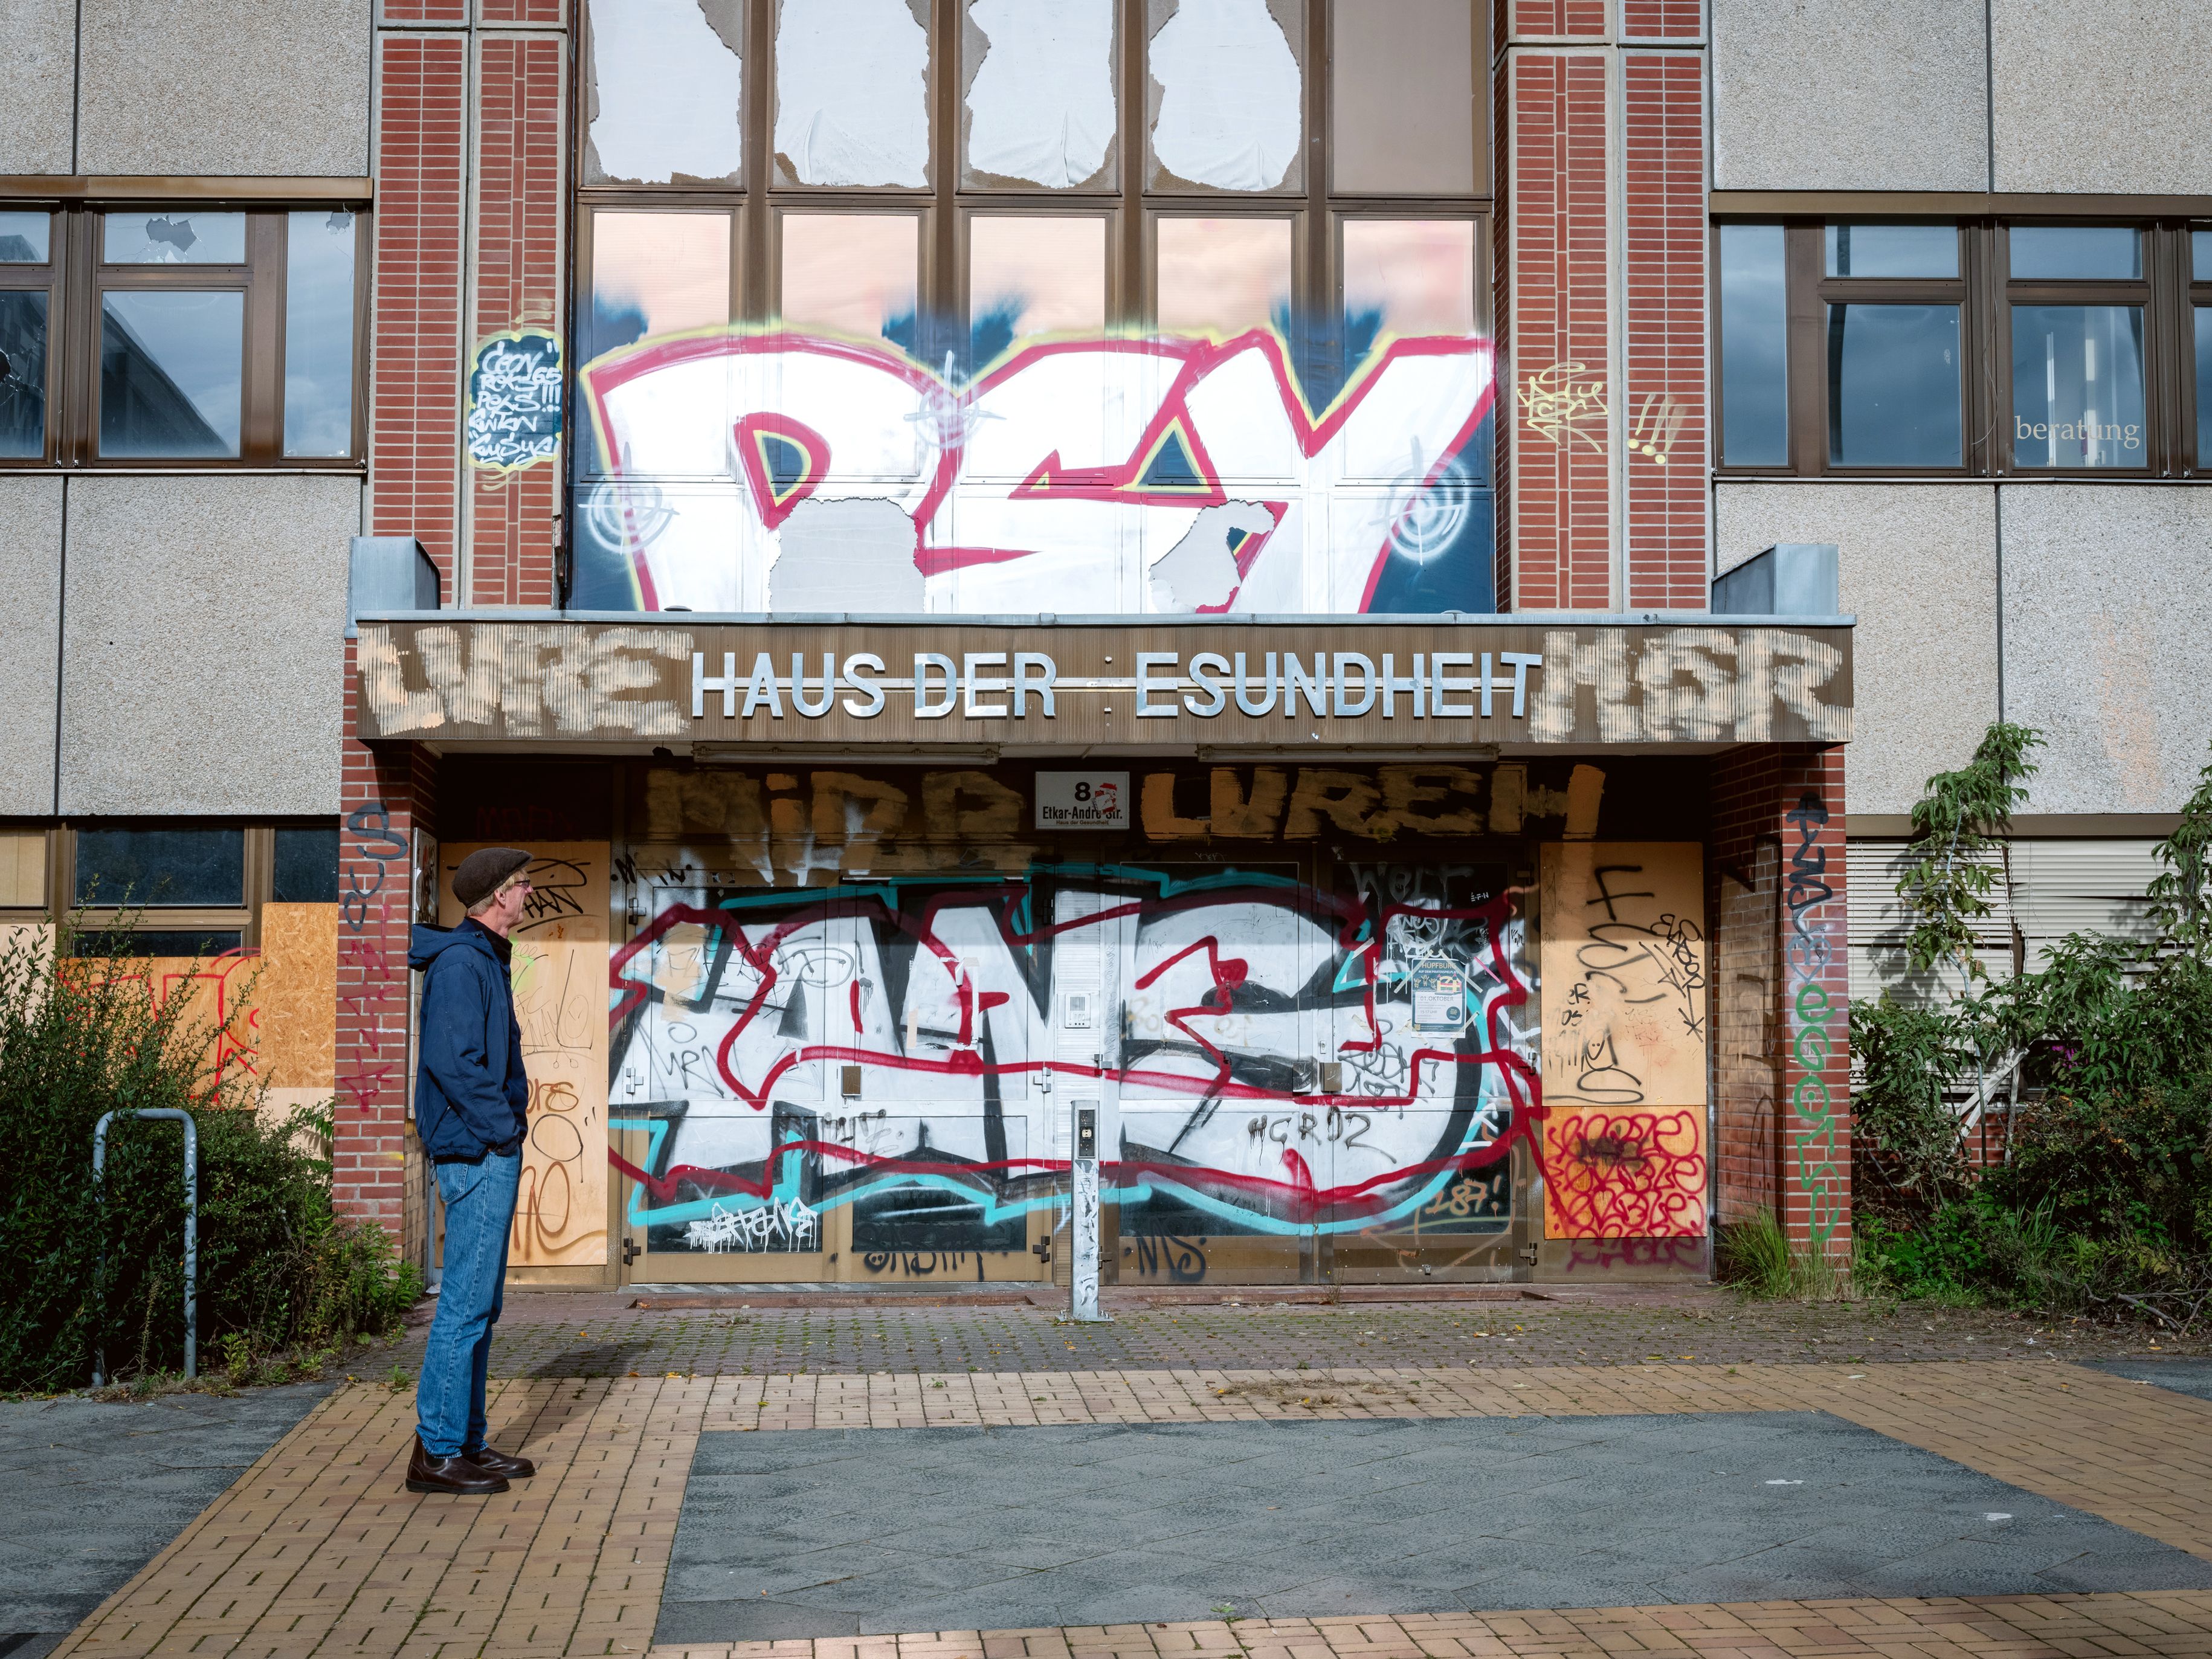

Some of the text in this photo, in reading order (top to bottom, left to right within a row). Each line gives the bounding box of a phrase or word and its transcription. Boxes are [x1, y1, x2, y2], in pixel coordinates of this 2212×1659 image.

[2014, 415, 2140, 449] beratung
[692, 652, 886, 718] HAUS
[914, 652, 1057, 718] DER
[1074, 781, 1092, 802] 8
